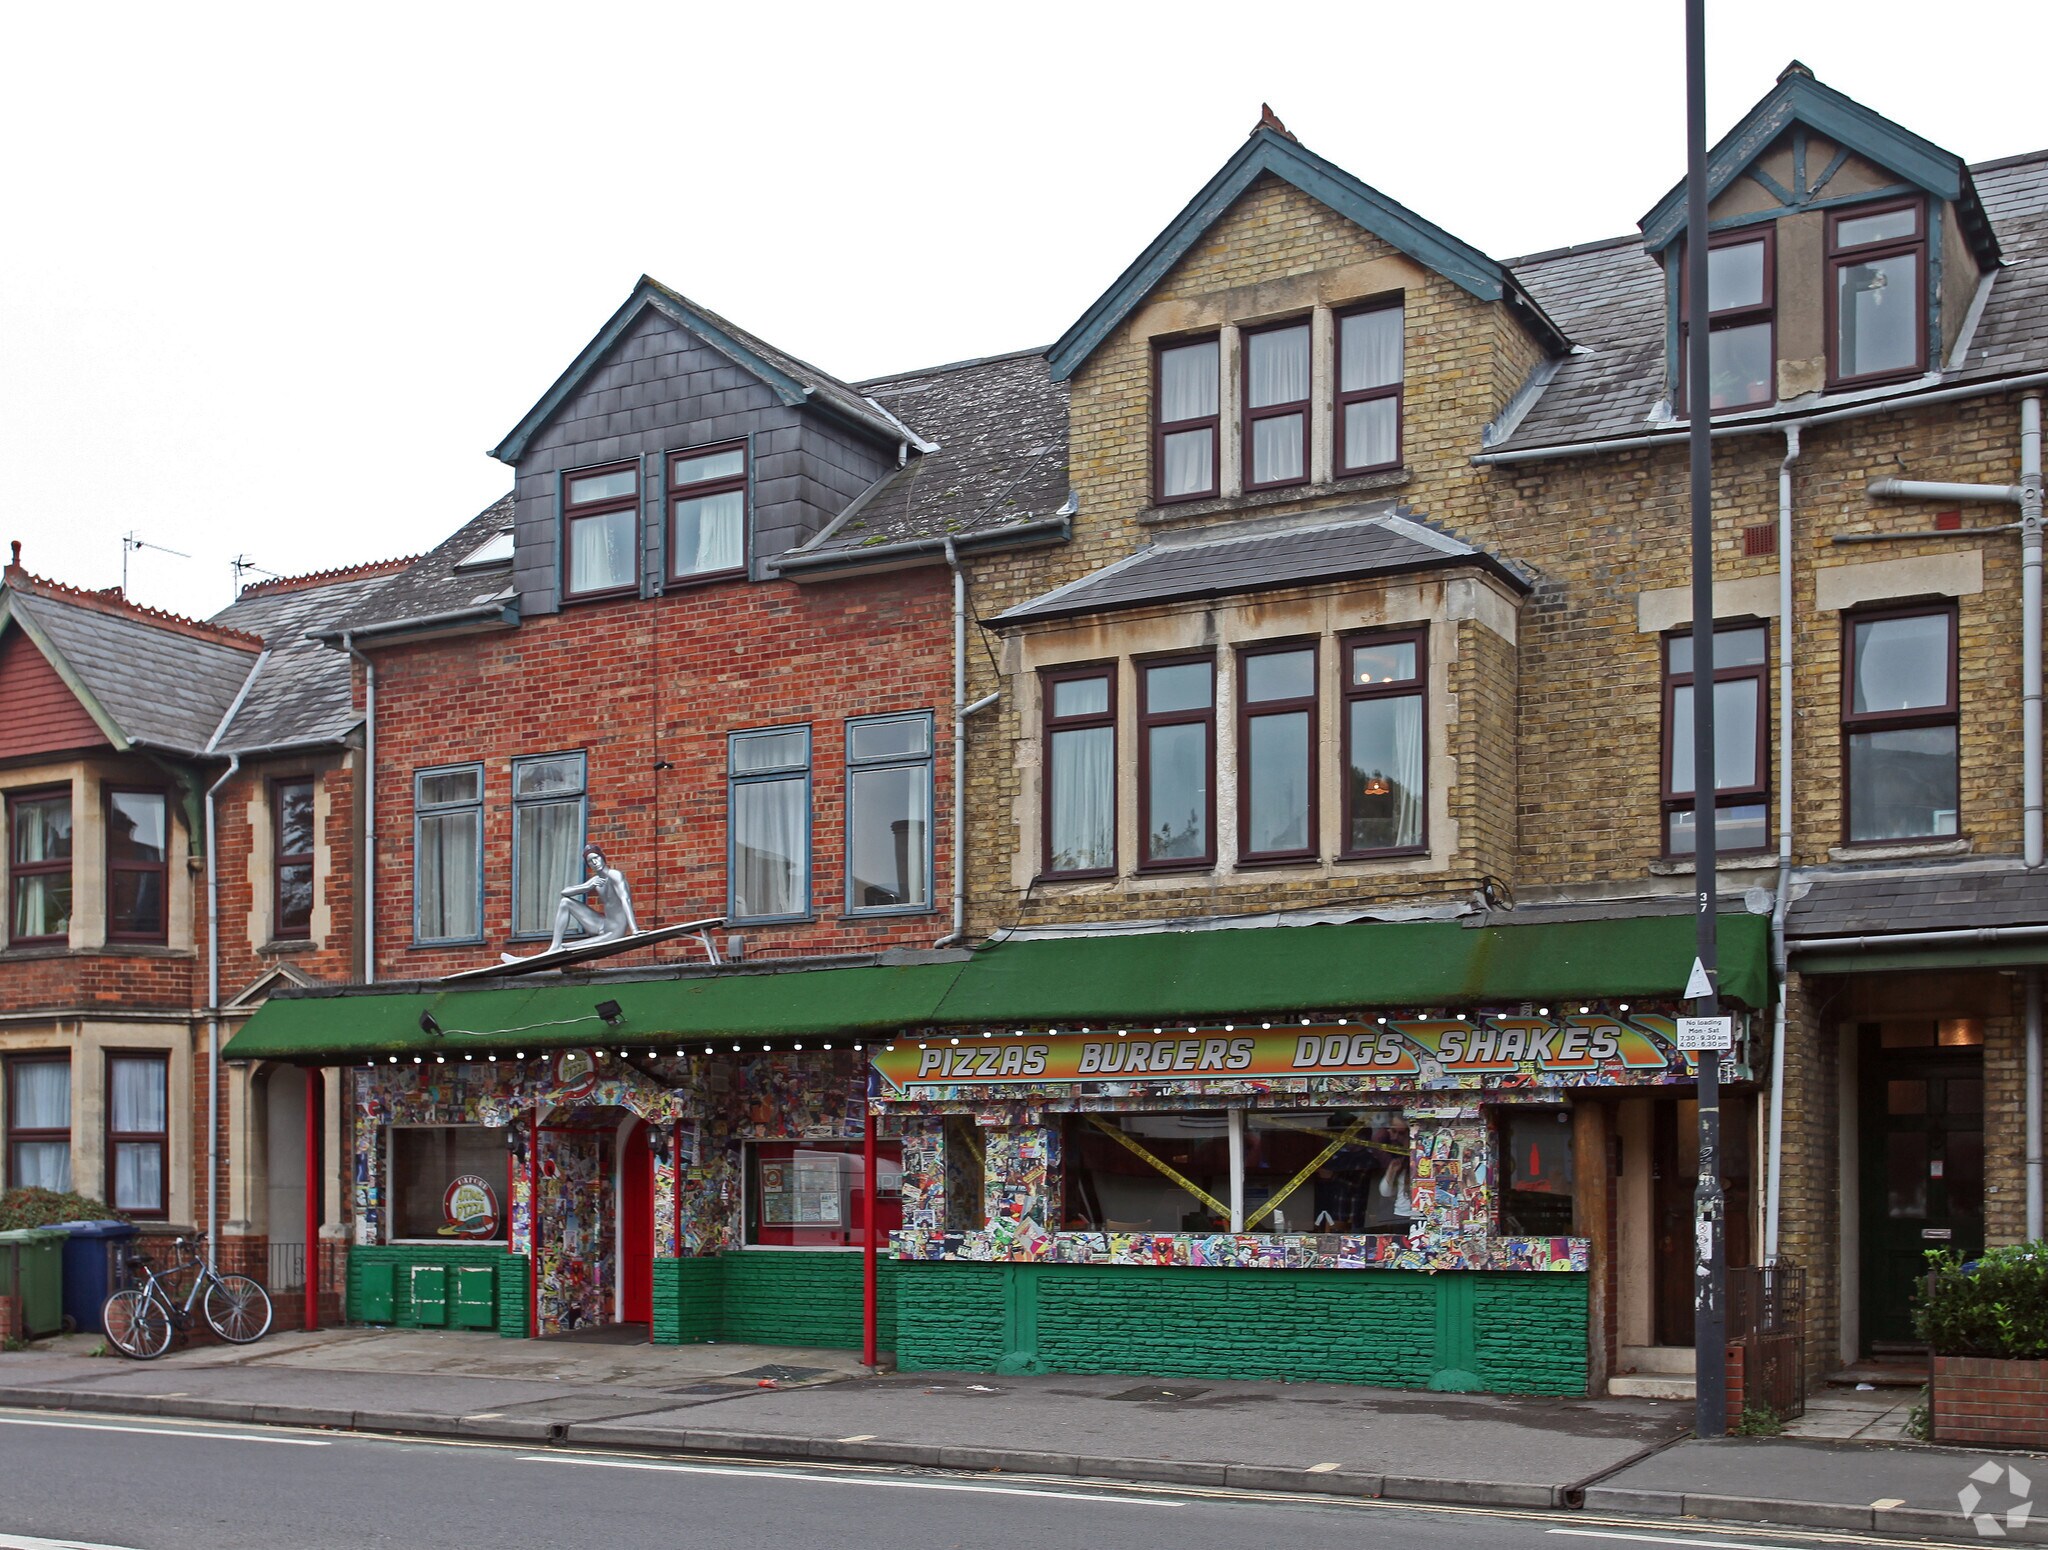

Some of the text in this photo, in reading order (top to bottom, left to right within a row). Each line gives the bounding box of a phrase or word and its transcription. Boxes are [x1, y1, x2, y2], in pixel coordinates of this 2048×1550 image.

[917, 1025, 1622, 1077] PIZZAS BURGERS DOGS SHAKES
[457, 1177, 489, 1190] OXFORD
[456, 1202, 485, 1219] PIZZA
